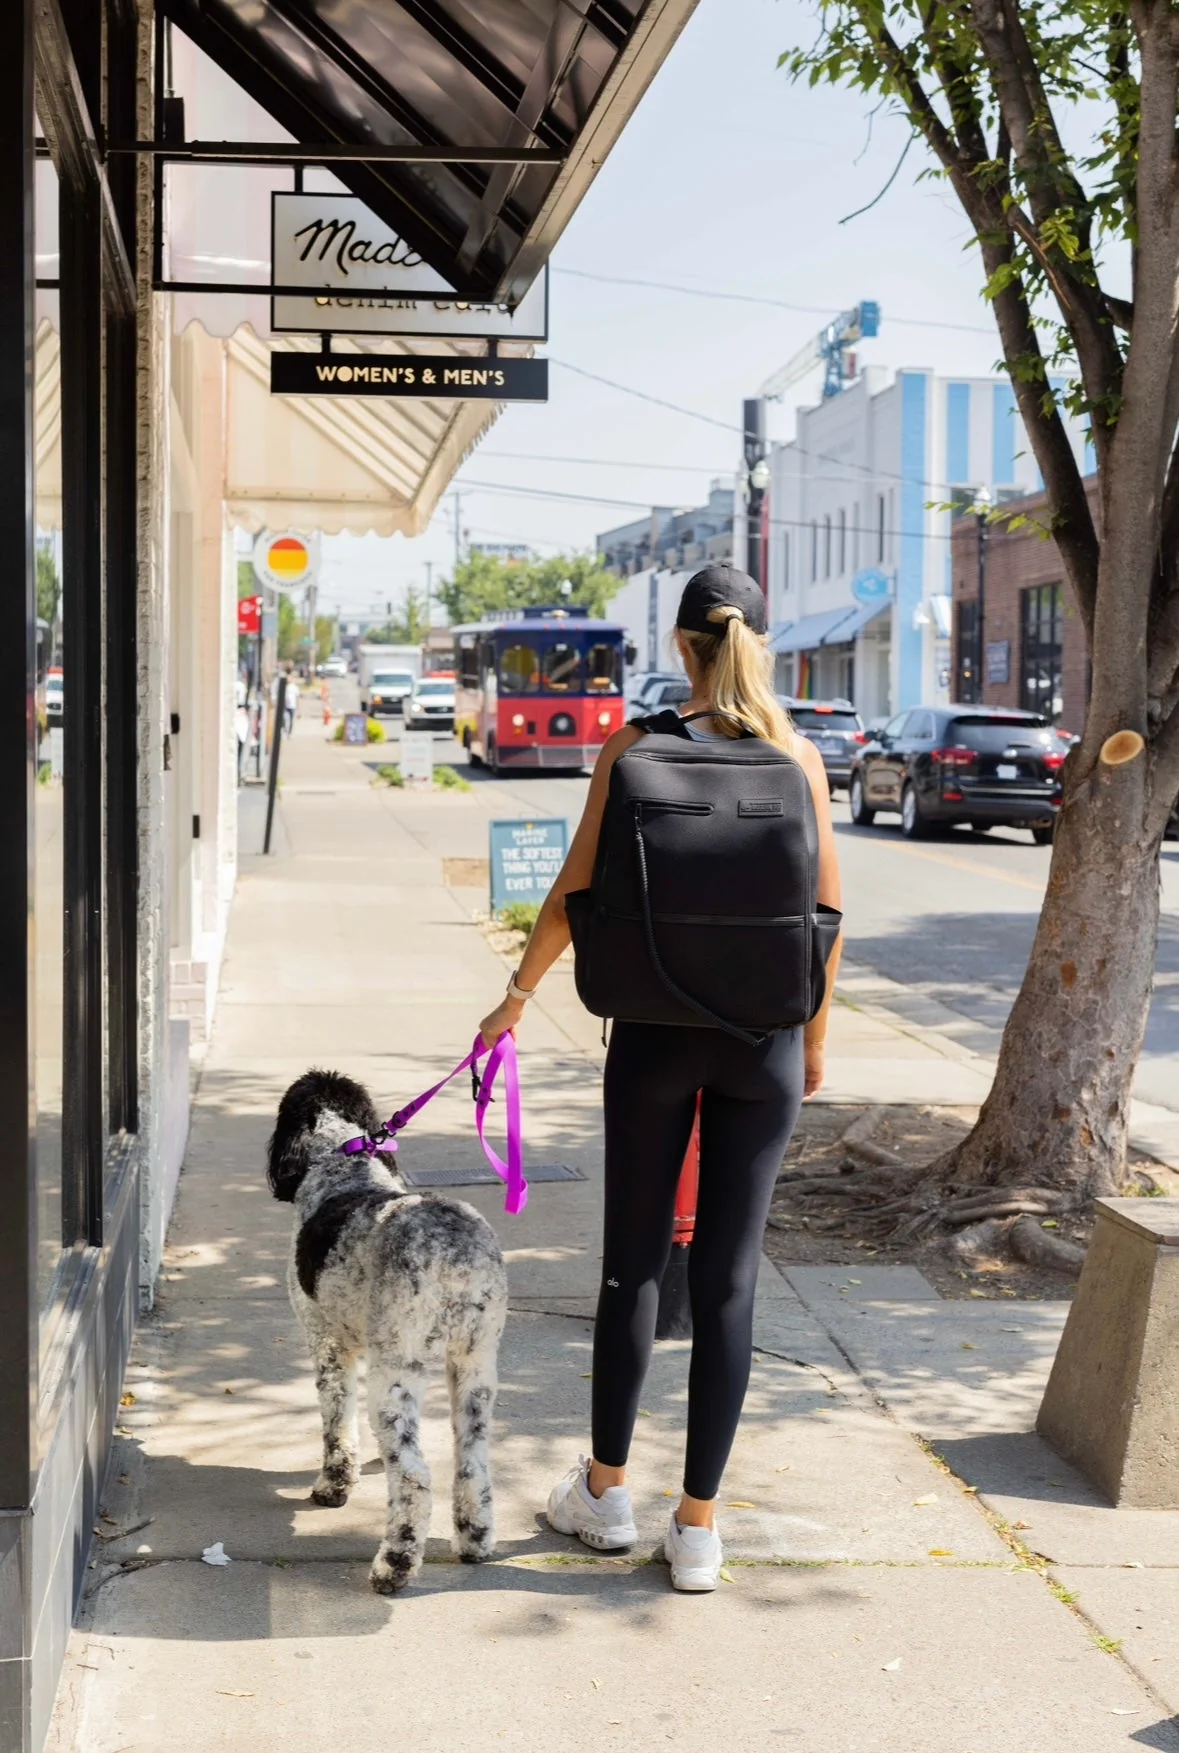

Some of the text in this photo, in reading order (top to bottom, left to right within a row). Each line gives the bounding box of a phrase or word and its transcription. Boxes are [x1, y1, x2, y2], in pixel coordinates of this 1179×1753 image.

[316, 365, 505, 386] WOMEN'S & MEN'S
[501, 848, 521, 860] THE
[505, 877, 532, 890] EVER
